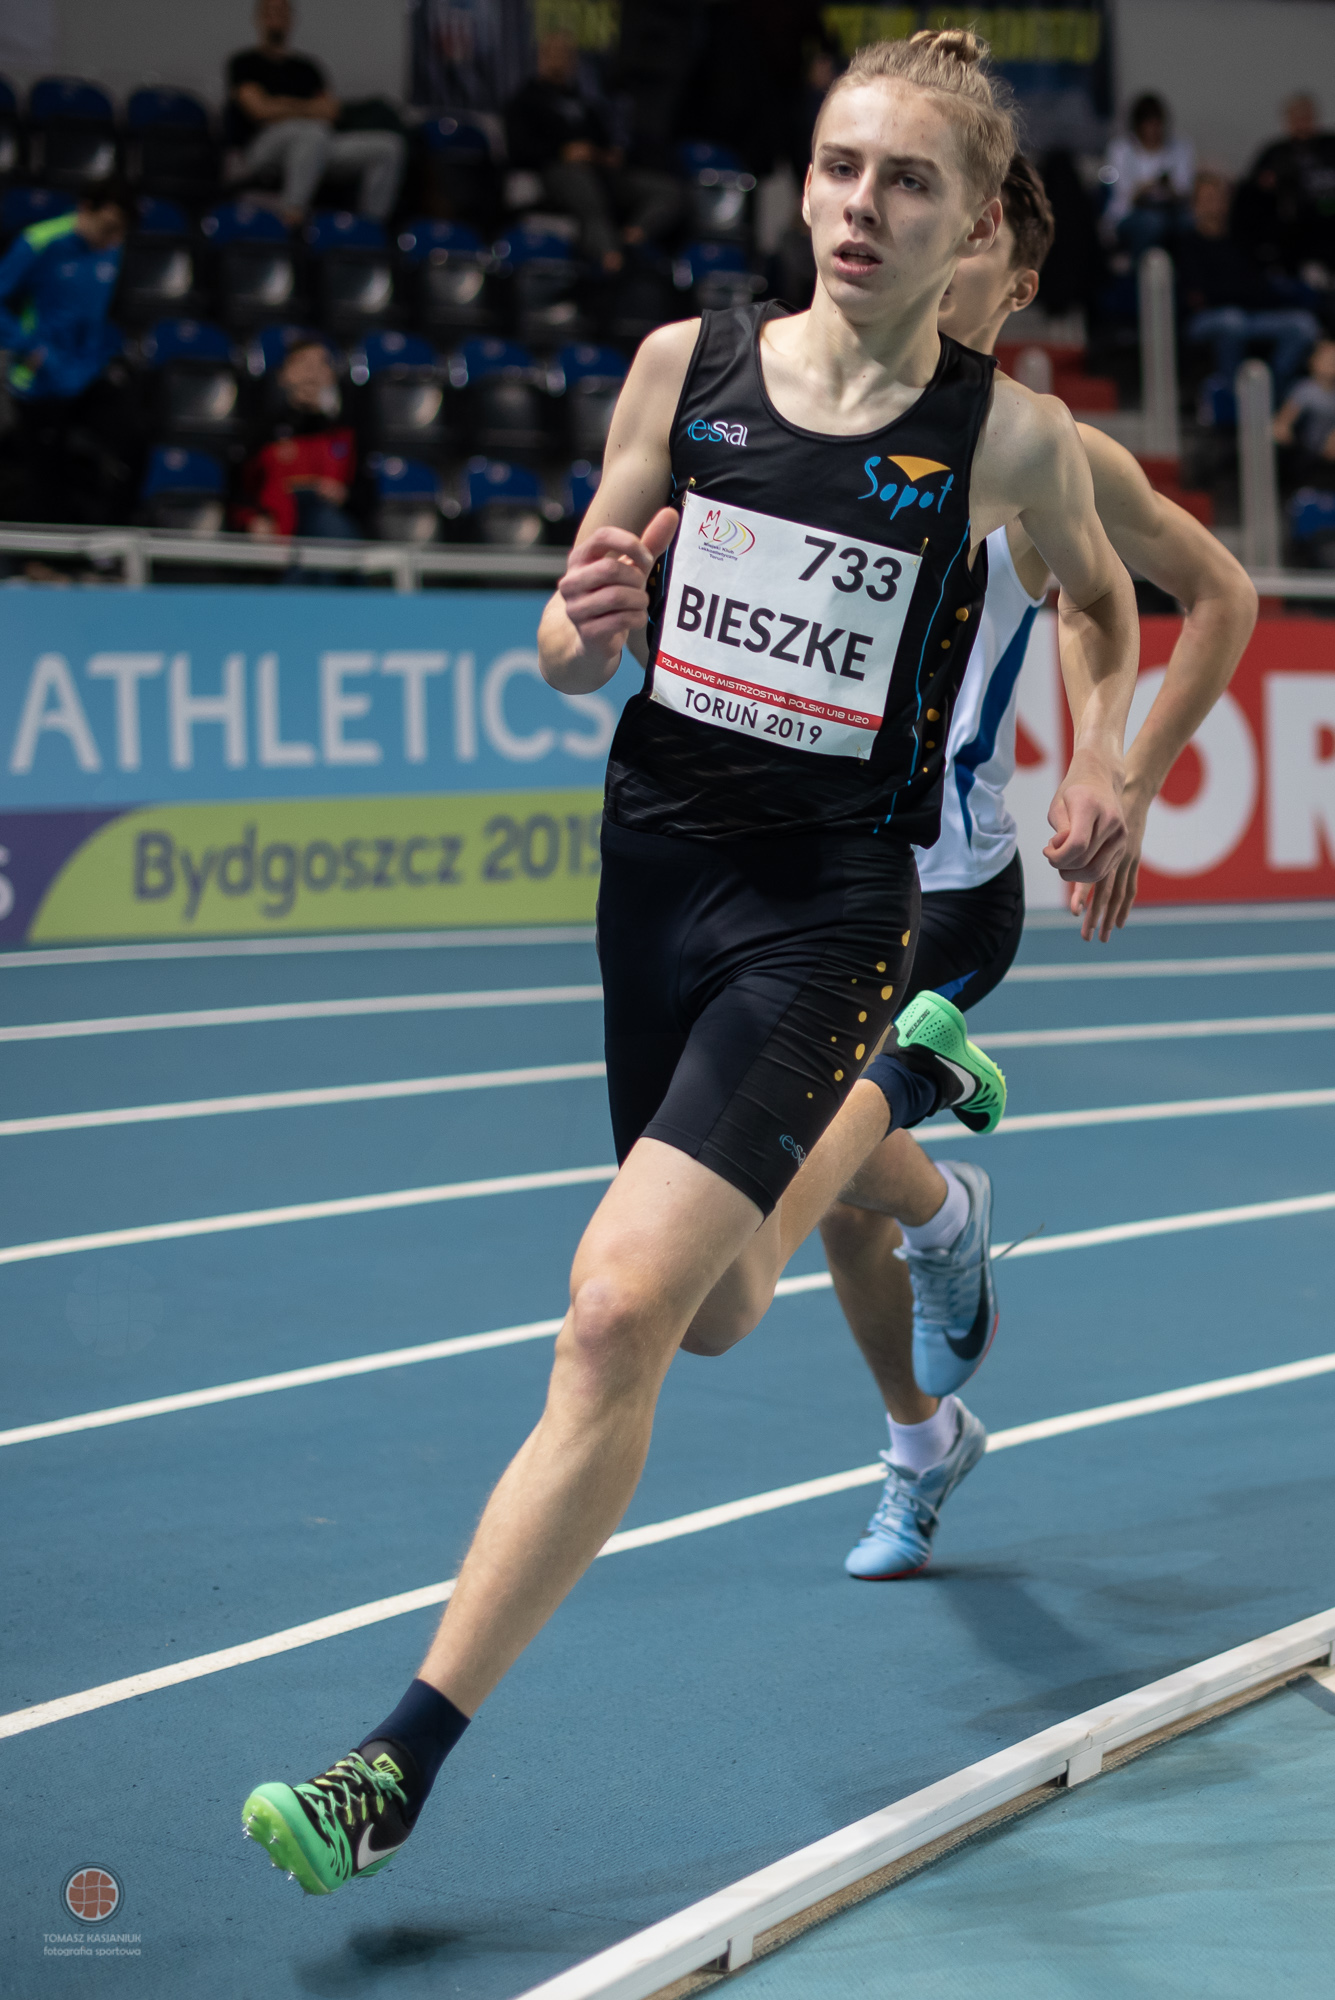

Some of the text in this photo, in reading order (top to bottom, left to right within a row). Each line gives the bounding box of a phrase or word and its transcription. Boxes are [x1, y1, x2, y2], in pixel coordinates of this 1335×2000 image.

[857, 455, 955, 521] Sopot
[798, 534, 903, 603] 733
[676, 583, 874, 682] BIESZKE
[9, 648, 617, 775] ATHLETICS
[661, 656, 870, 725] PZLA HALOWE MISTRZOSTWA POLSKI U18 U20
[685, 687, 823, 746] TORUŃ 2019
[132, 822, 464, 923] Bydgoszcz
